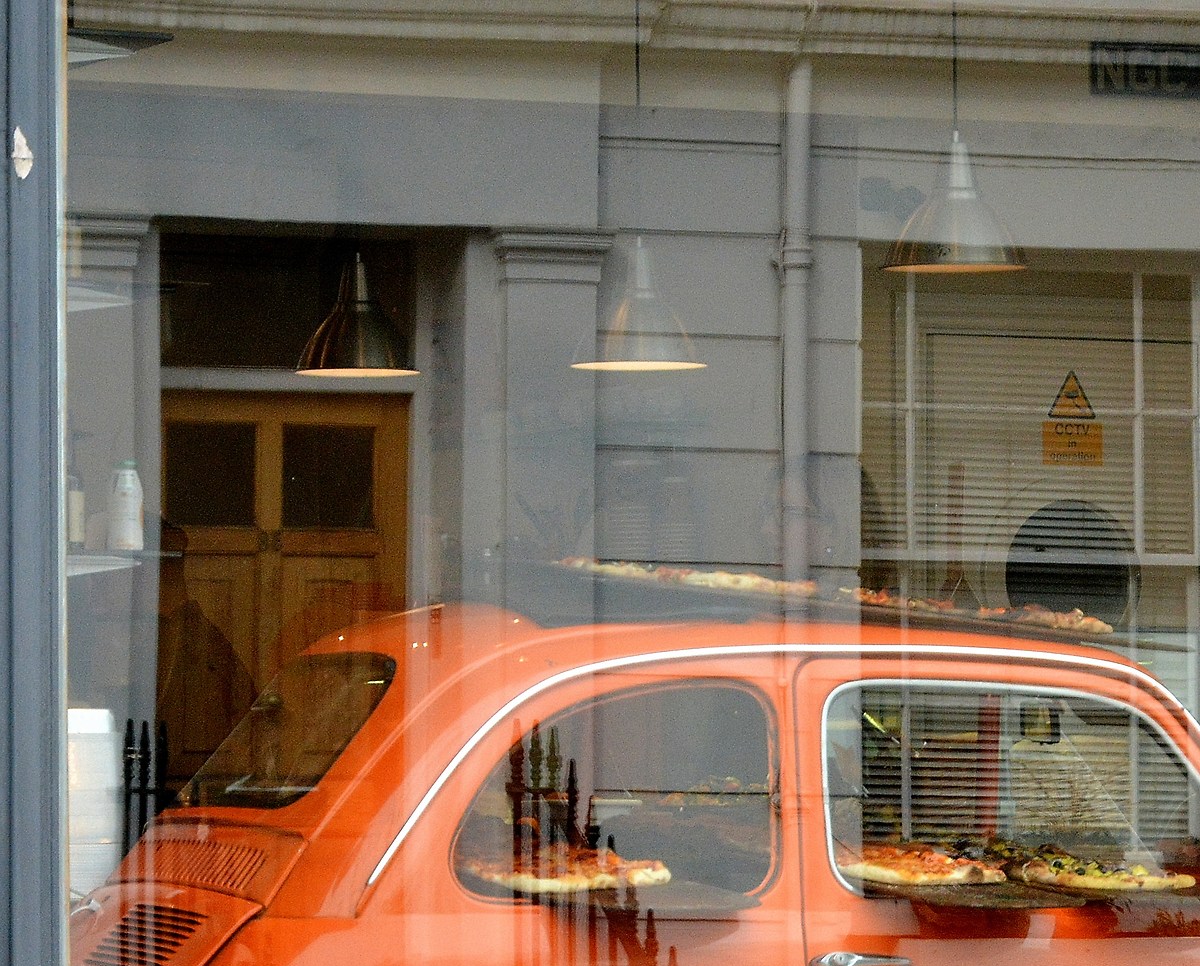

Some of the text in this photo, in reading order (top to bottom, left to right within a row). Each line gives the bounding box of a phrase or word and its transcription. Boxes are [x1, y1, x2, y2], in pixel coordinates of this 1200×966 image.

[1054, 423, 1090, 435] CCTV
[1068, 440, 1077, 448] in
[1050, 451, 1096, 463] operation
